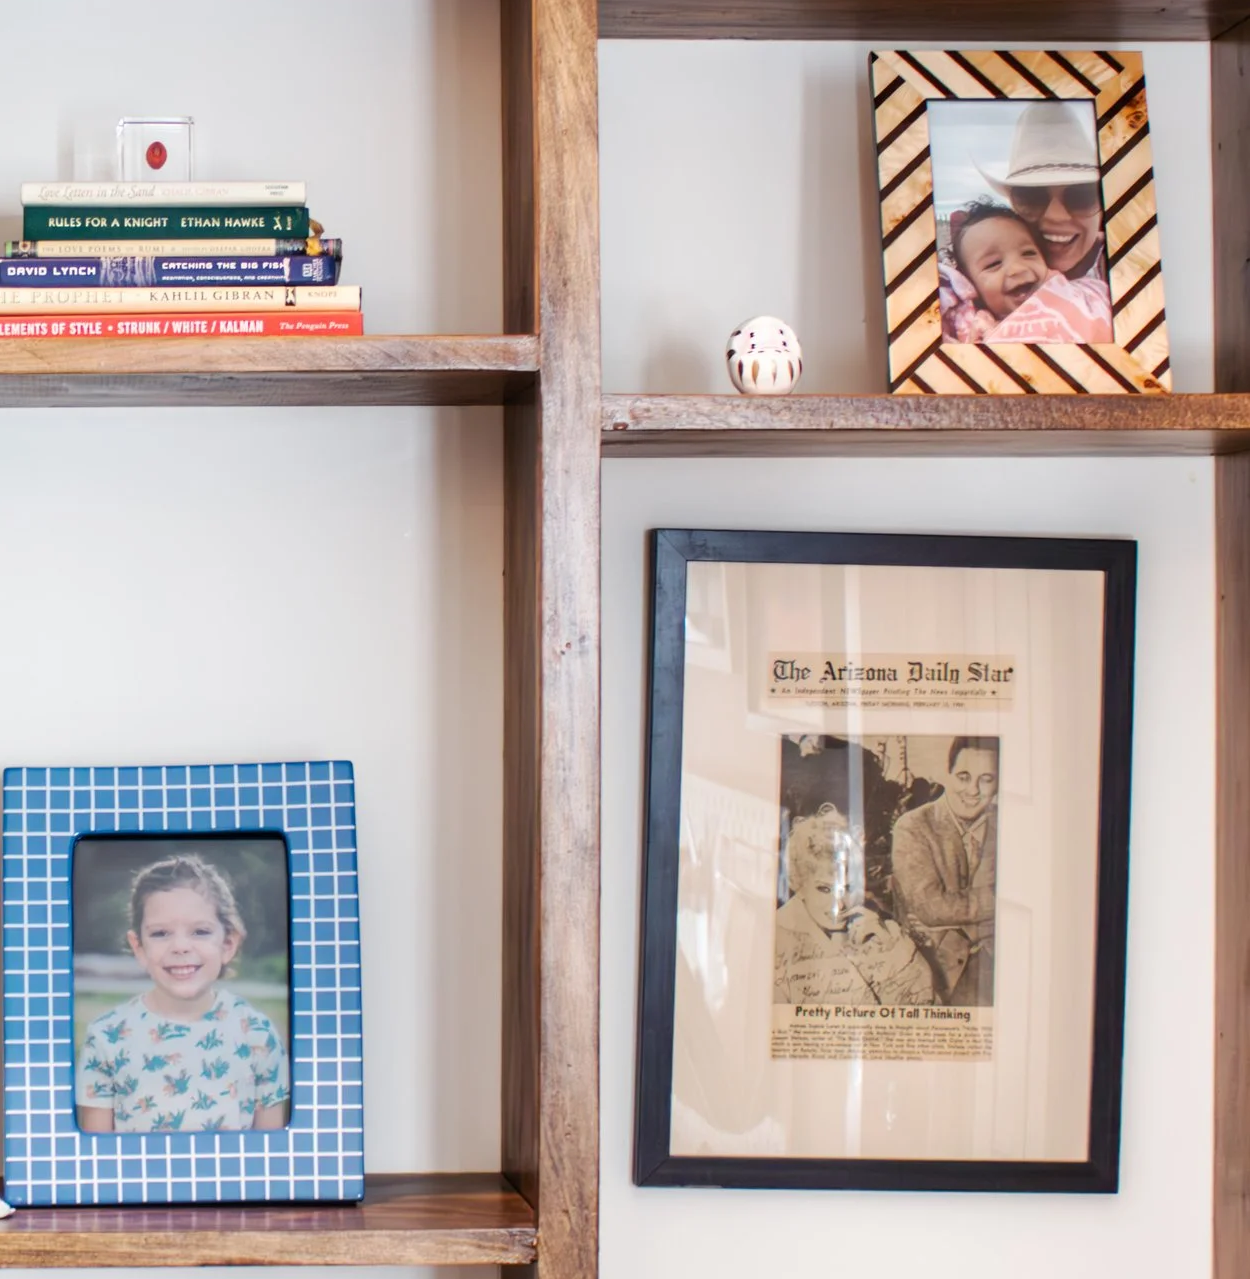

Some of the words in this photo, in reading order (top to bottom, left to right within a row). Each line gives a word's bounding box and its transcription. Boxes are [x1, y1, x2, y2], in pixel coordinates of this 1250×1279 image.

[48, 217, 82, 227] RULES
[85, 217, 108, 227] FOR
[111, 217, 120, 227] A
[124, 217, 168, 227] KNIGHT
[180, 217, 220, 227] ETHAN
[224, 217, 266, 227] HAWKE
[7, 266, 47, 276] DAVID
[53, 266, 96, 276] LYNCH
[161, 262, 212, 270] CATCHING
[216, 262, 236, 270] THE
[241, 262, 258, 270] BIG
[30, 290, 124, 304] PROPHET
[149, 291, 208, 302] KAHLIL
[213, 290, 274, 302] GIBRAN
[51, 322, 65, 335] OF
[69, 322, 102, 335] STYLE
[117, 321, 161, 335] STRUNK
[172, 320, 208, 334] WHITE
[219, 320, 264, 333] KALMAN
[280, 322, 294, 330] The
[298, 322, 327, 332] Penguin
[329, 322, 349, 330] Press
[773, 659, 812, 683] The
[819, 660, 898, 684] Arizona
[907, 661, 960, 685] Daily
[967, 662, 1014, 683] Star
[795, 1006, 831, 1020] Pretty
[834, 1006, 876, 1018] Picture
[879, 1007, 895, 1018] Of
[899, 1007, 920, 1019] Tall
[922, 1008, 971, 1022] Thinking
